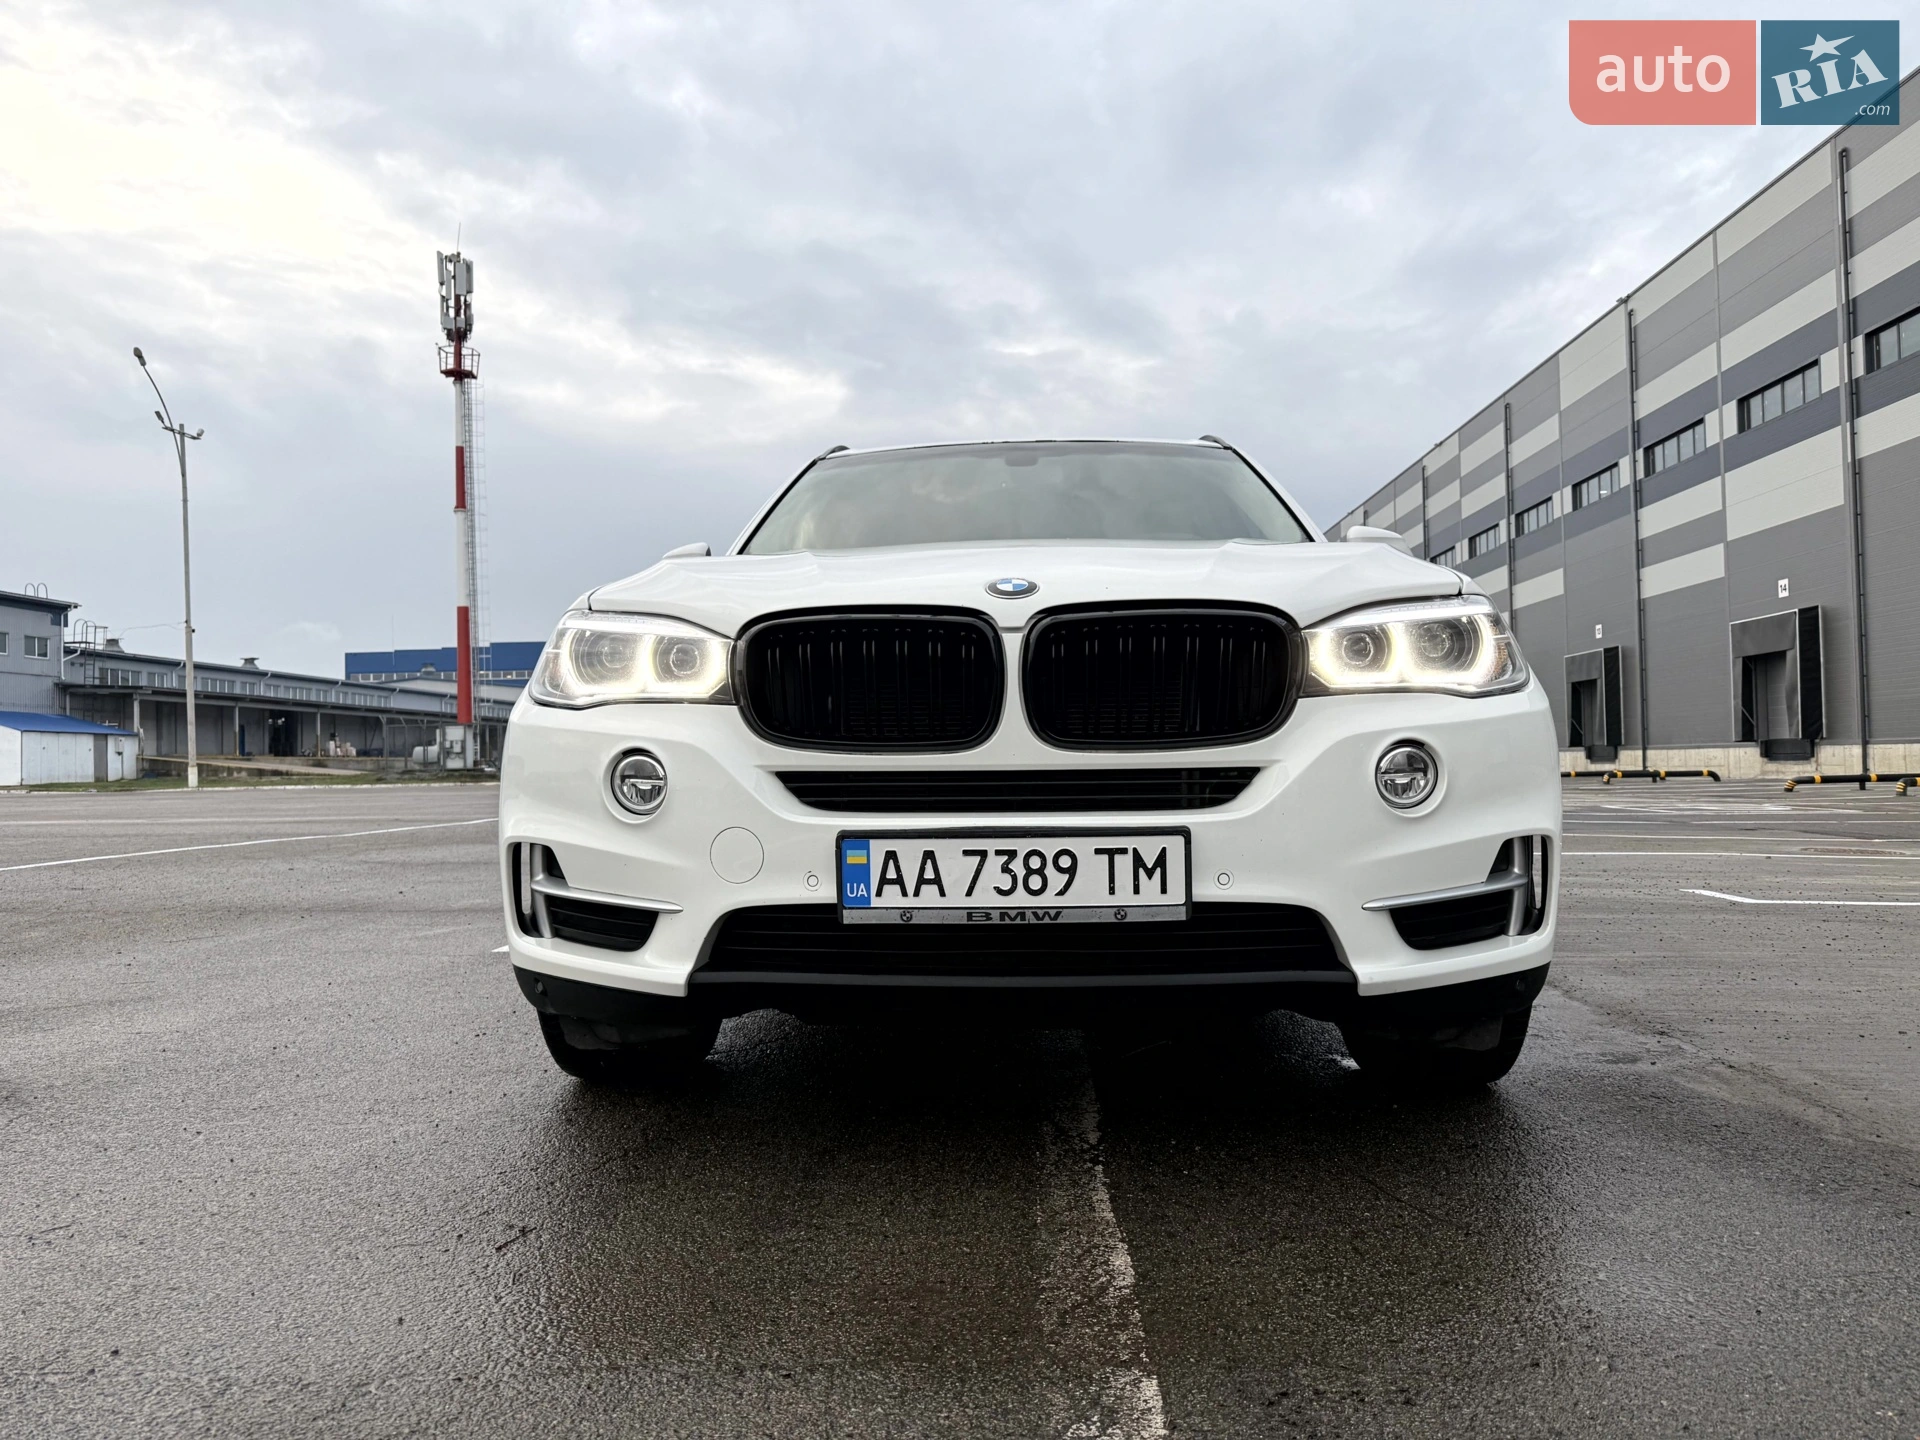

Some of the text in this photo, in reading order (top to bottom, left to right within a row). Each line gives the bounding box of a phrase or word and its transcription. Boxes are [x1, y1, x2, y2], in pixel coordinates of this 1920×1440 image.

[1780, 583, 1787, 593] 14
[875, 846, 1168, 898] AA 7389 TM
[847, 882, 868, 898] UA
[966, 910, 1063, 923] BMW
